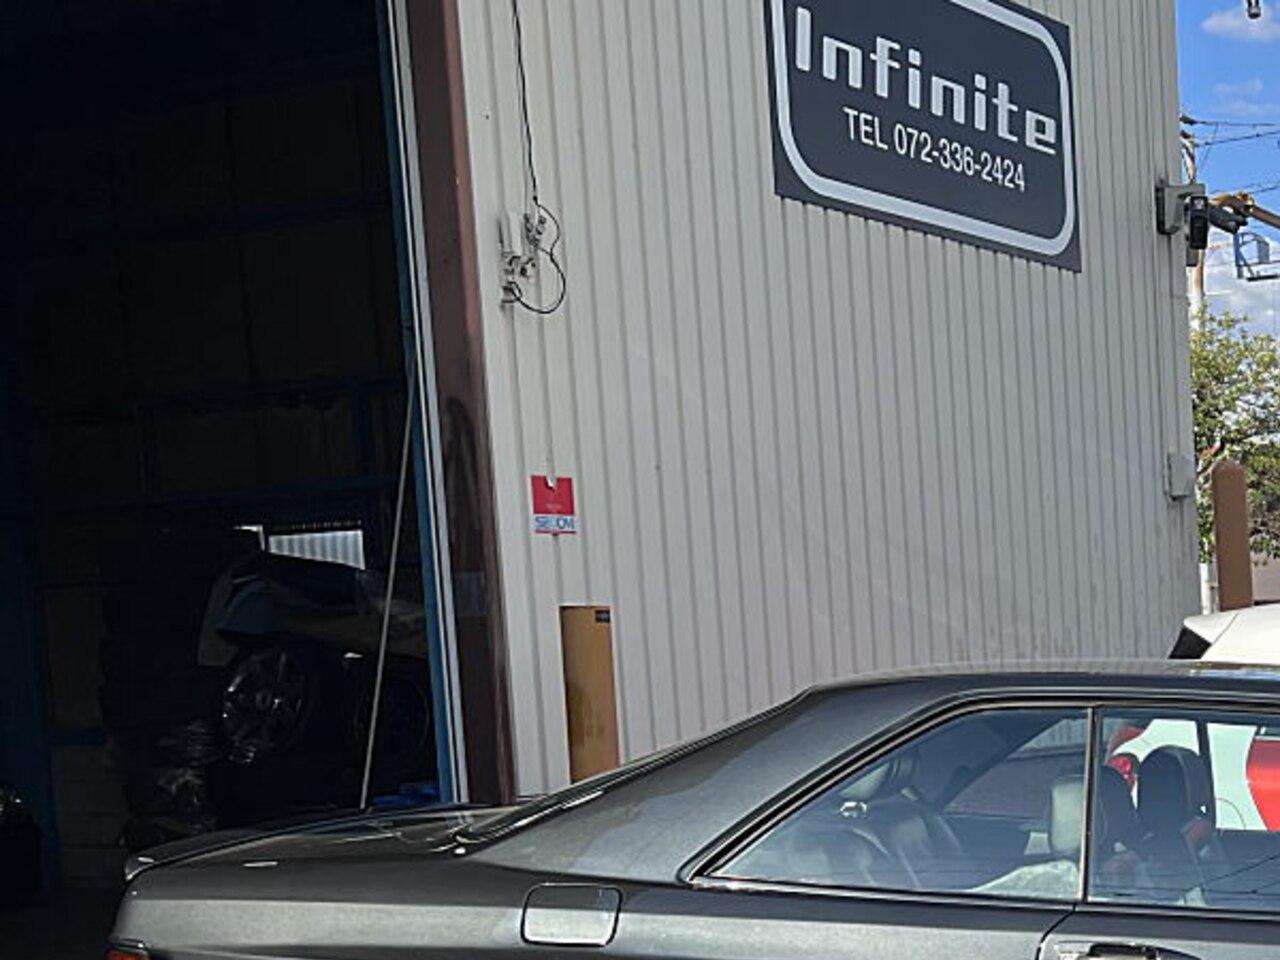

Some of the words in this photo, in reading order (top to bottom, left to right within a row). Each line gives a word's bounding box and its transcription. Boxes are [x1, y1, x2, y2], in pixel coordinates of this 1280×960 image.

[795, 6, 1056, 155] Infinite
[843, 106, 888, 151] TEL
[893, 123, 1025, 192] 072-336-2424
